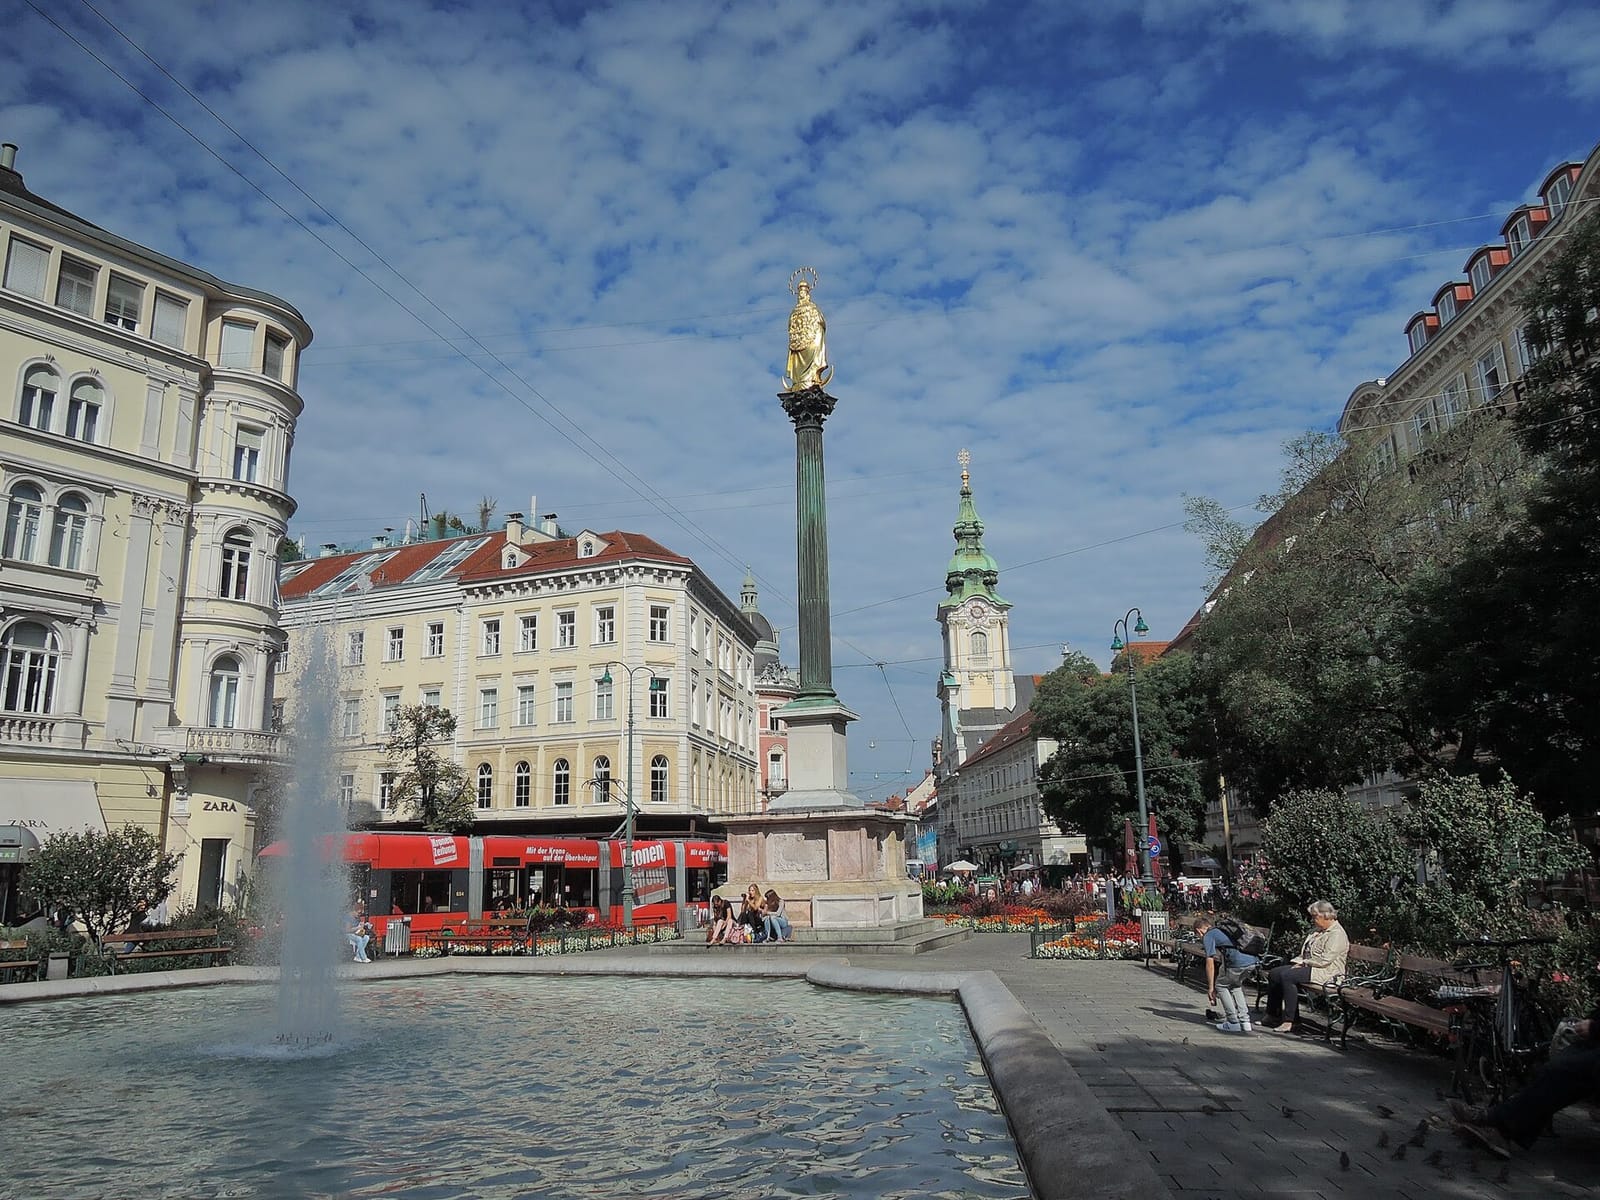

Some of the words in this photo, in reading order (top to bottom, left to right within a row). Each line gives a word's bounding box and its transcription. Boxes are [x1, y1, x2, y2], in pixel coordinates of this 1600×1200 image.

[203, 801, 238, 812] ZARA
[7, 819, 48, 828] ZARA
[526, 846, 537, 855] Mit
[537, 846, 548, 855] der
[554, 853, 564, 861] der
[631, 866, 665, 890] eitung
